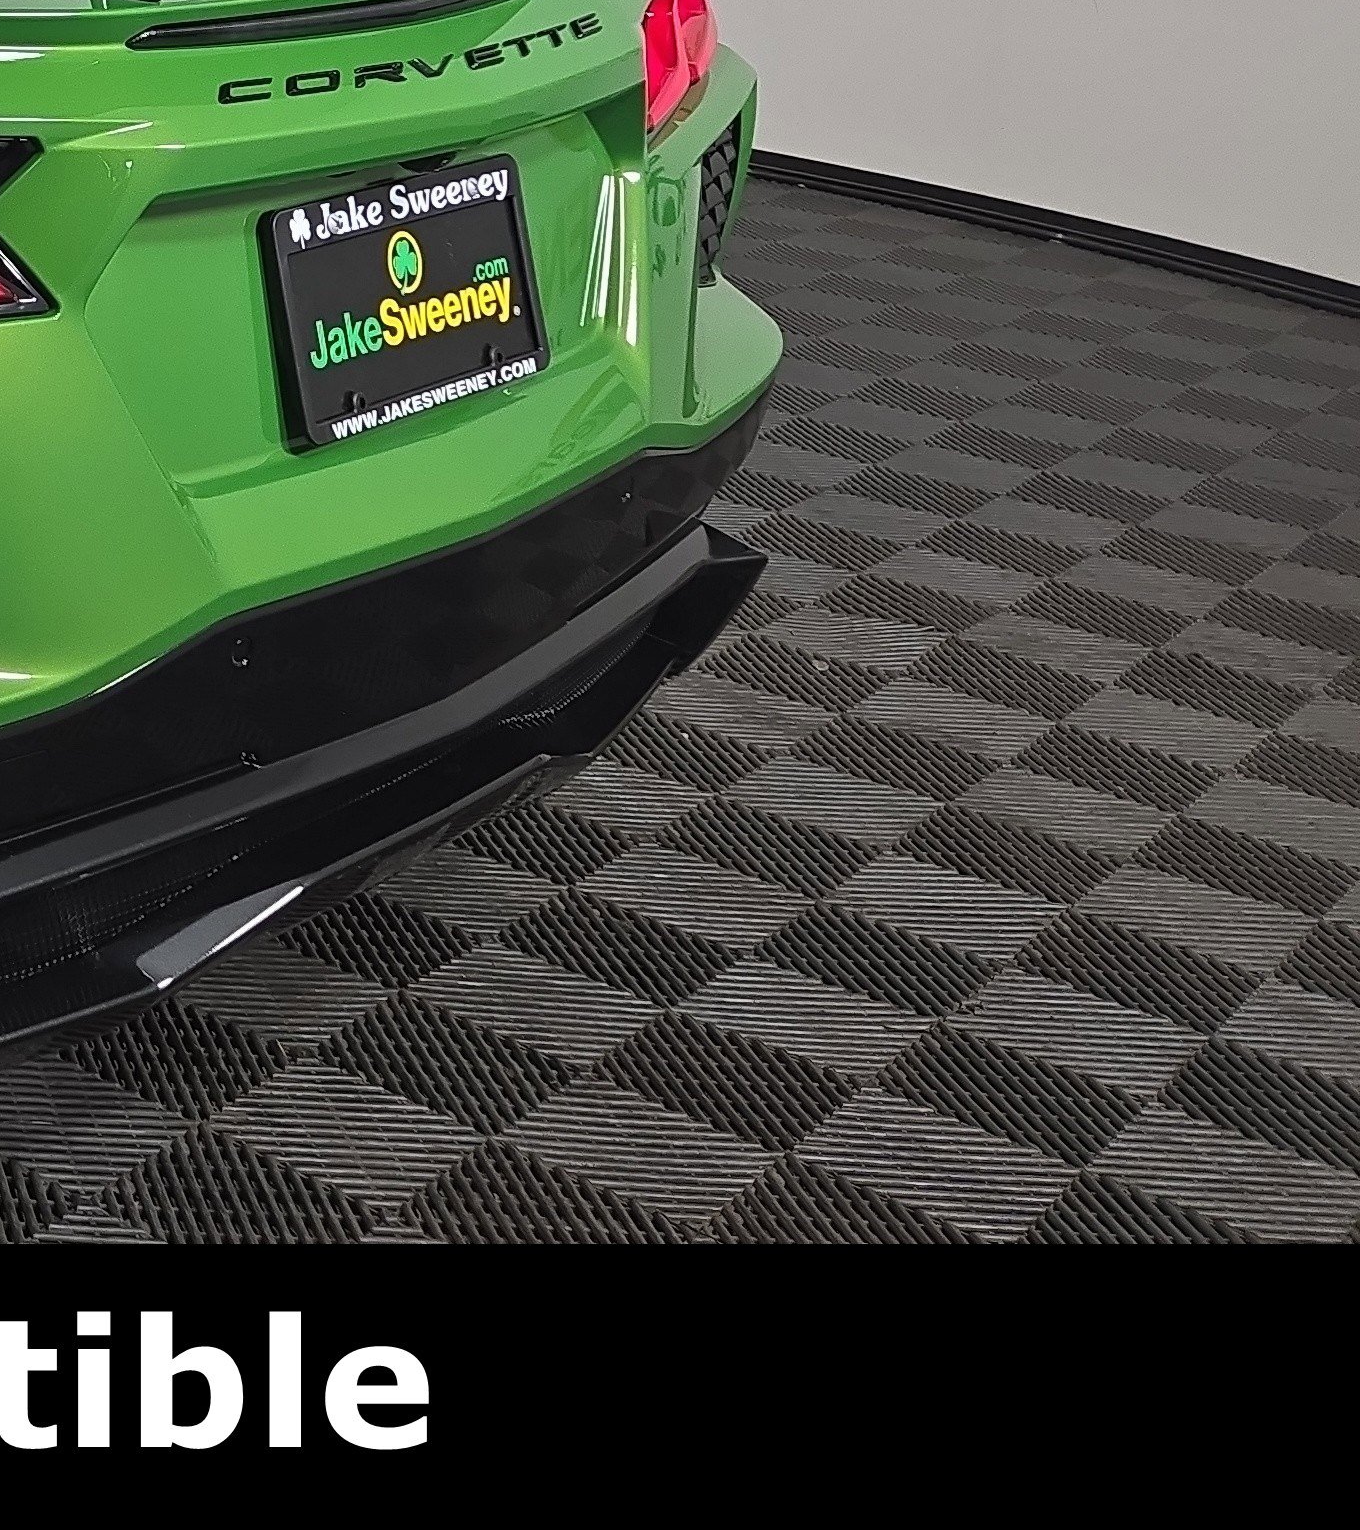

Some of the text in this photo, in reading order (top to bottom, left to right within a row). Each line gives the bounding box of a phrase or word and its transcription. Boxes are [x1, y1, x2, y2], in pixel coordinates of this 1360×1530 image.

[216, 12, 604, 105] CORVETTE
[315, 168, 509, 240] Jake Sweeney
[472, 256, 509, 283] .com
[331, 357, 538, 440] WWW.JAKESWEENEY.COM
